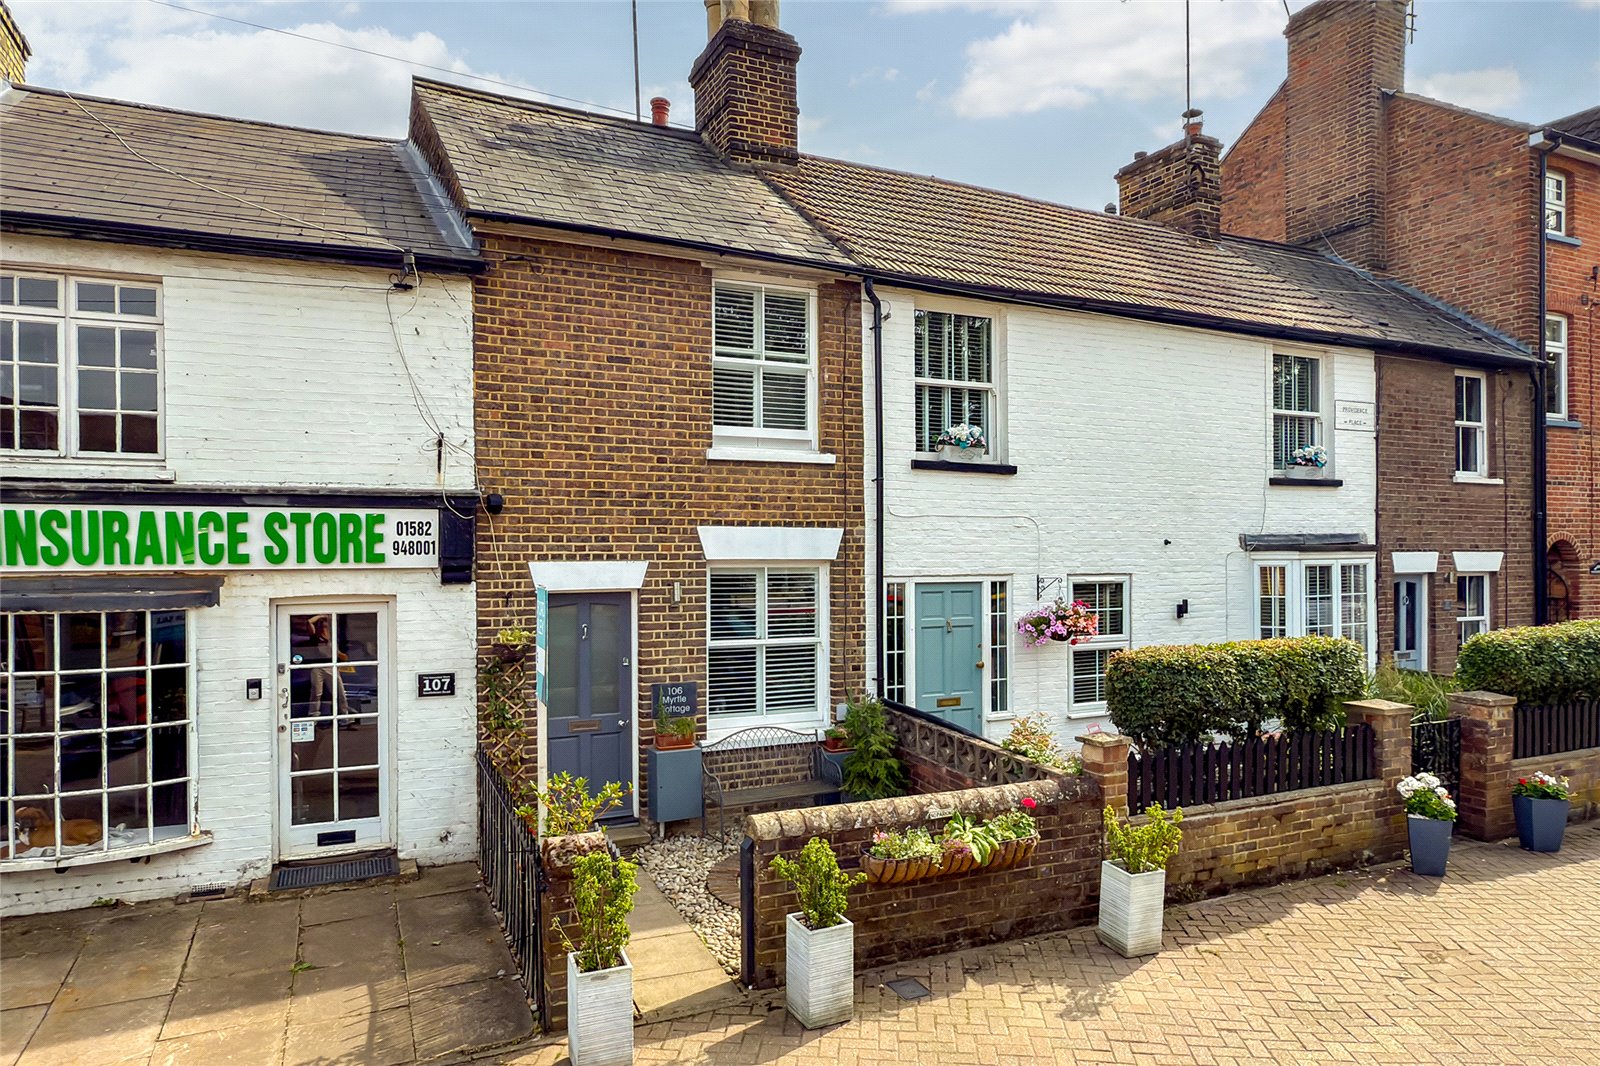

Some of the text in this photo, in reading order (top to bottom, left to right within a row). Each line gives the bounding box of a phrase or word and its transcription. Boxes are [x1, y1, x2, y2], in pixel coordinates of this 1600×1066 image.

[396, 520, 432, 536] 01582
[0, 509, 386, 566] NSURANCE STORE
[392, 540, 436, 556] 948001
[423, 678, 451, 691] 107
[667, 686, 683, 695] 106
[662, 695, 687, 705] Myrtle
